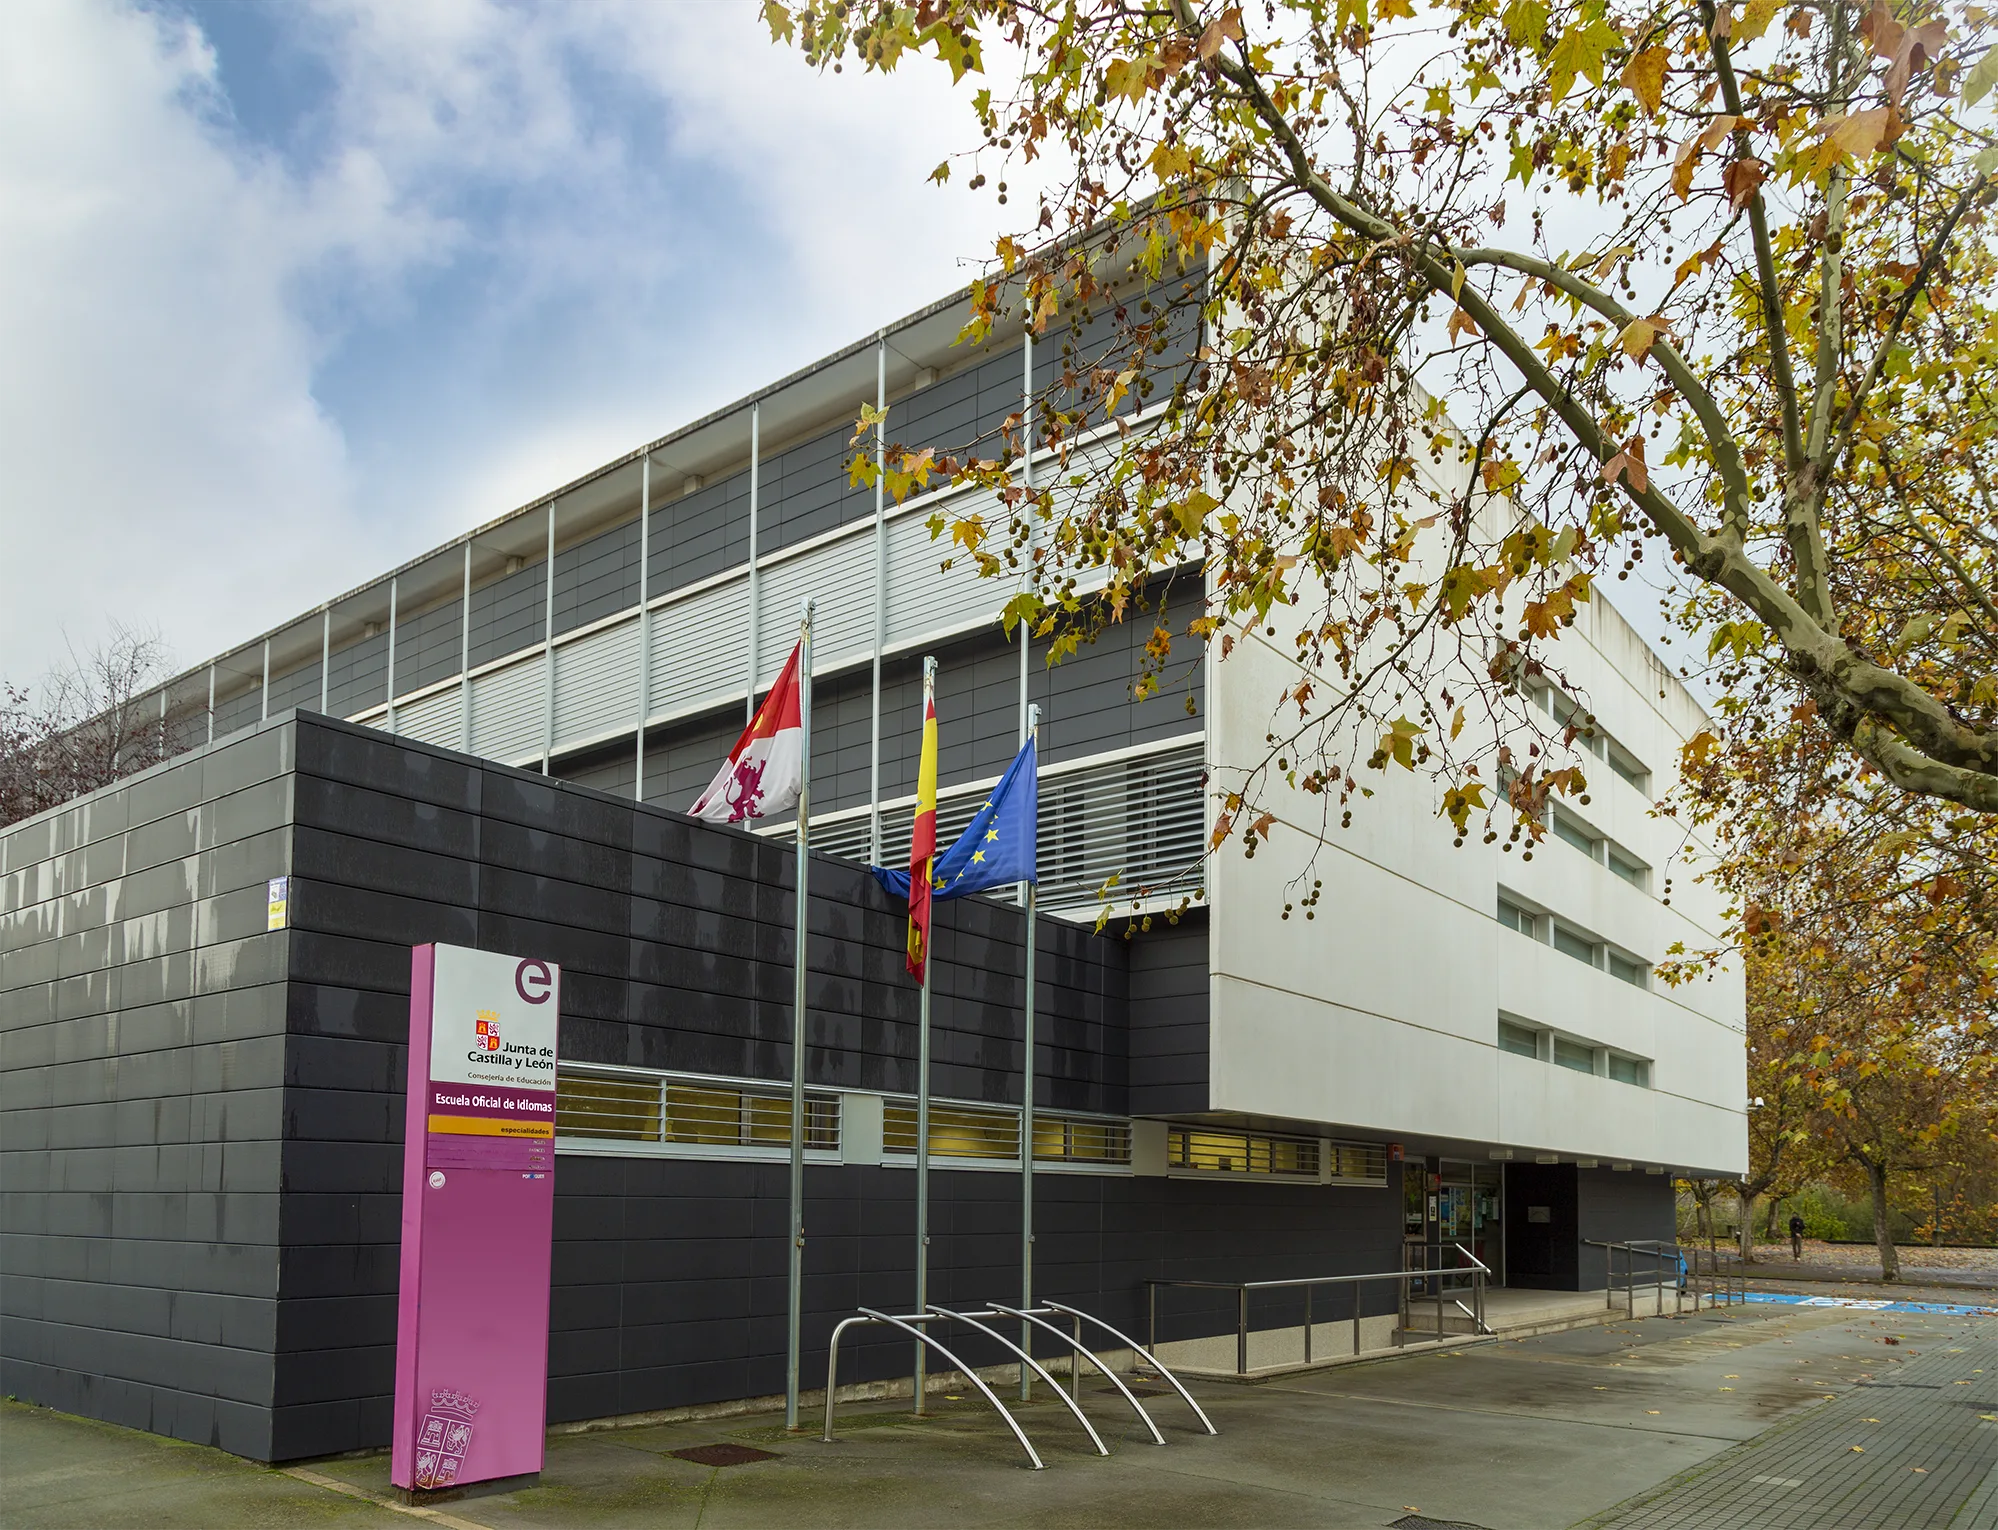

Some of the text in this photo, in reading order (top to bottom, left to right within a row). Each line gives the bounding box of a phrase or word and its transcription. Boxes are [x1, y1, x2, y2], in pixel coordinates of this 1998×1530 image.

[515, 958, 552, 1005] e
[502, 1042, 554, 1057] Junta de
[467, 1051, 554, 1070] Castilla y León
[467, 1072, 552, 1086] Consejería de Educación
[435, 1093, 553, 1112] Escuela Oficial de Idiomas
[501, 1127, 550, 1135] especialidades
